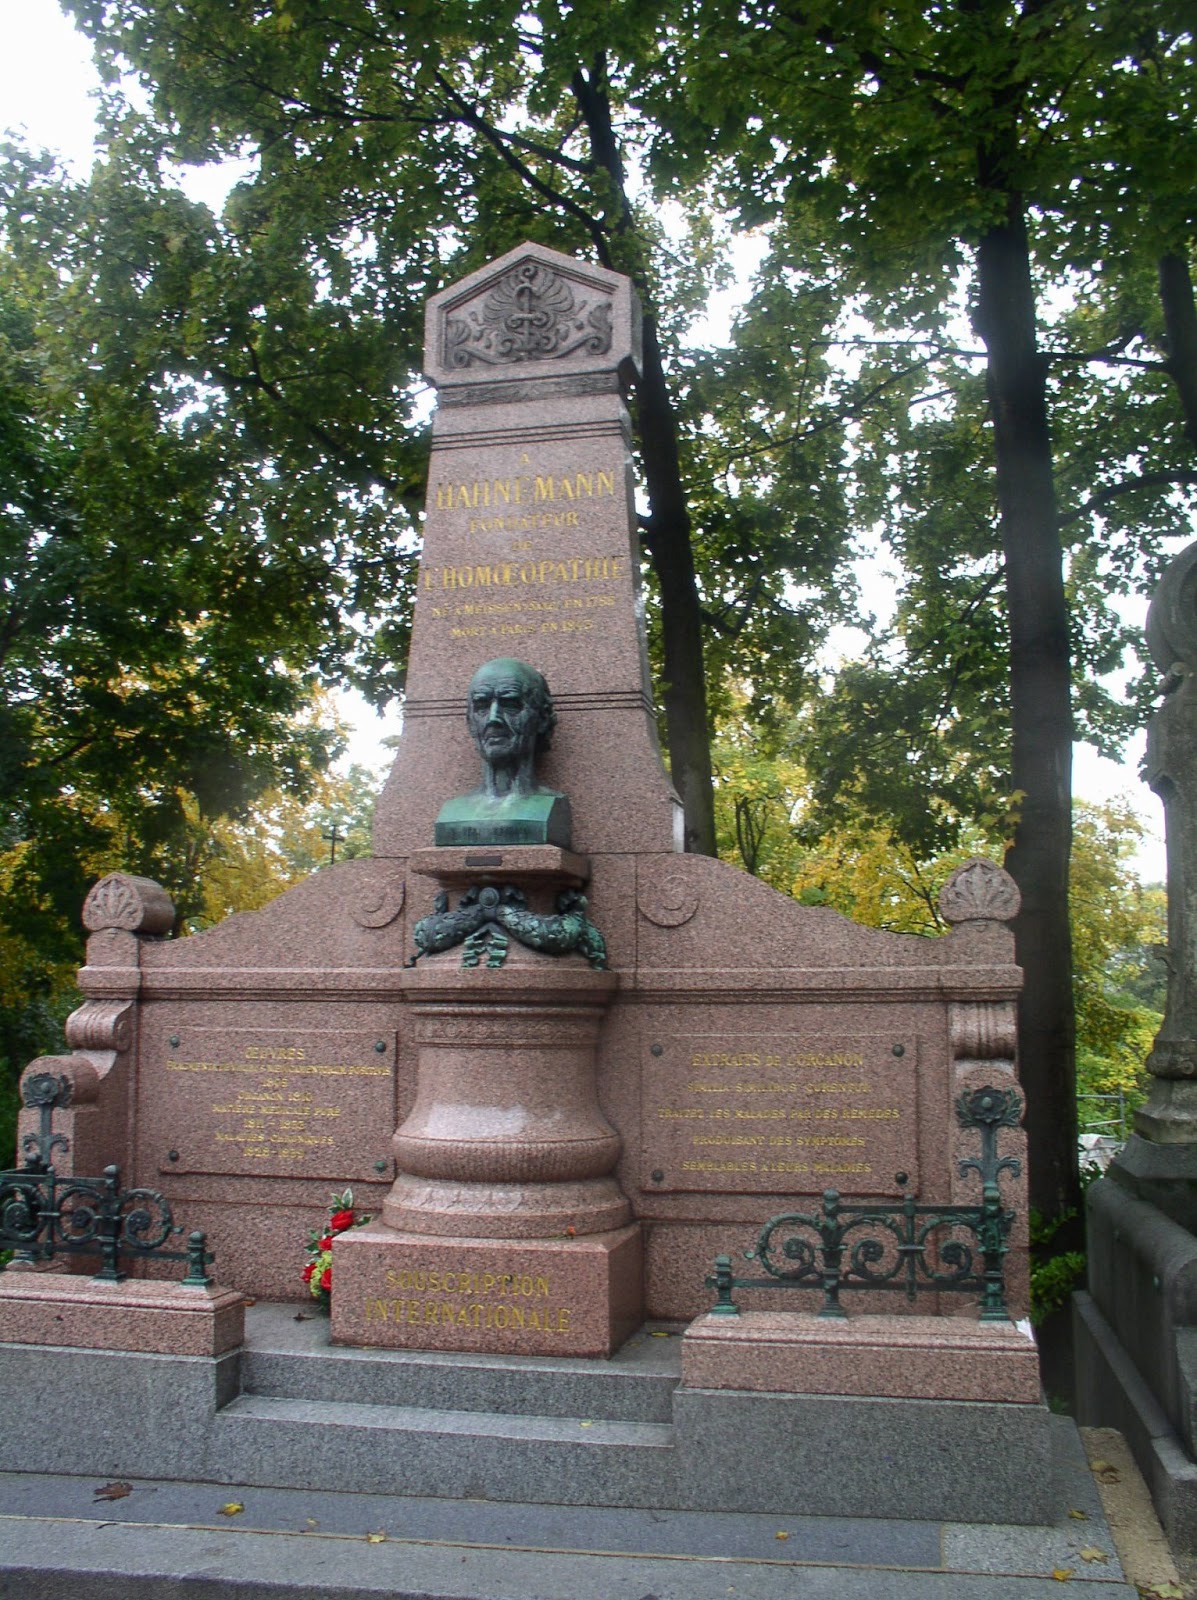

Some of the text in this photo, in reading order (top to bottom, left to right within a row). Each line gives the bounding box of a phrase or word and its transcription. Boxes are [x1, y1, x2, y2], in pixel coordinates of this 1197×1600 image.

[436, 469, 615, 510] HAHNEMANN
[469, 511, 580, 534] FONDATEUR
[385, 1268, 551, 1298] SOUSCRIPTION
[364, 1297, 572, 1333] INTERNATIONALE
